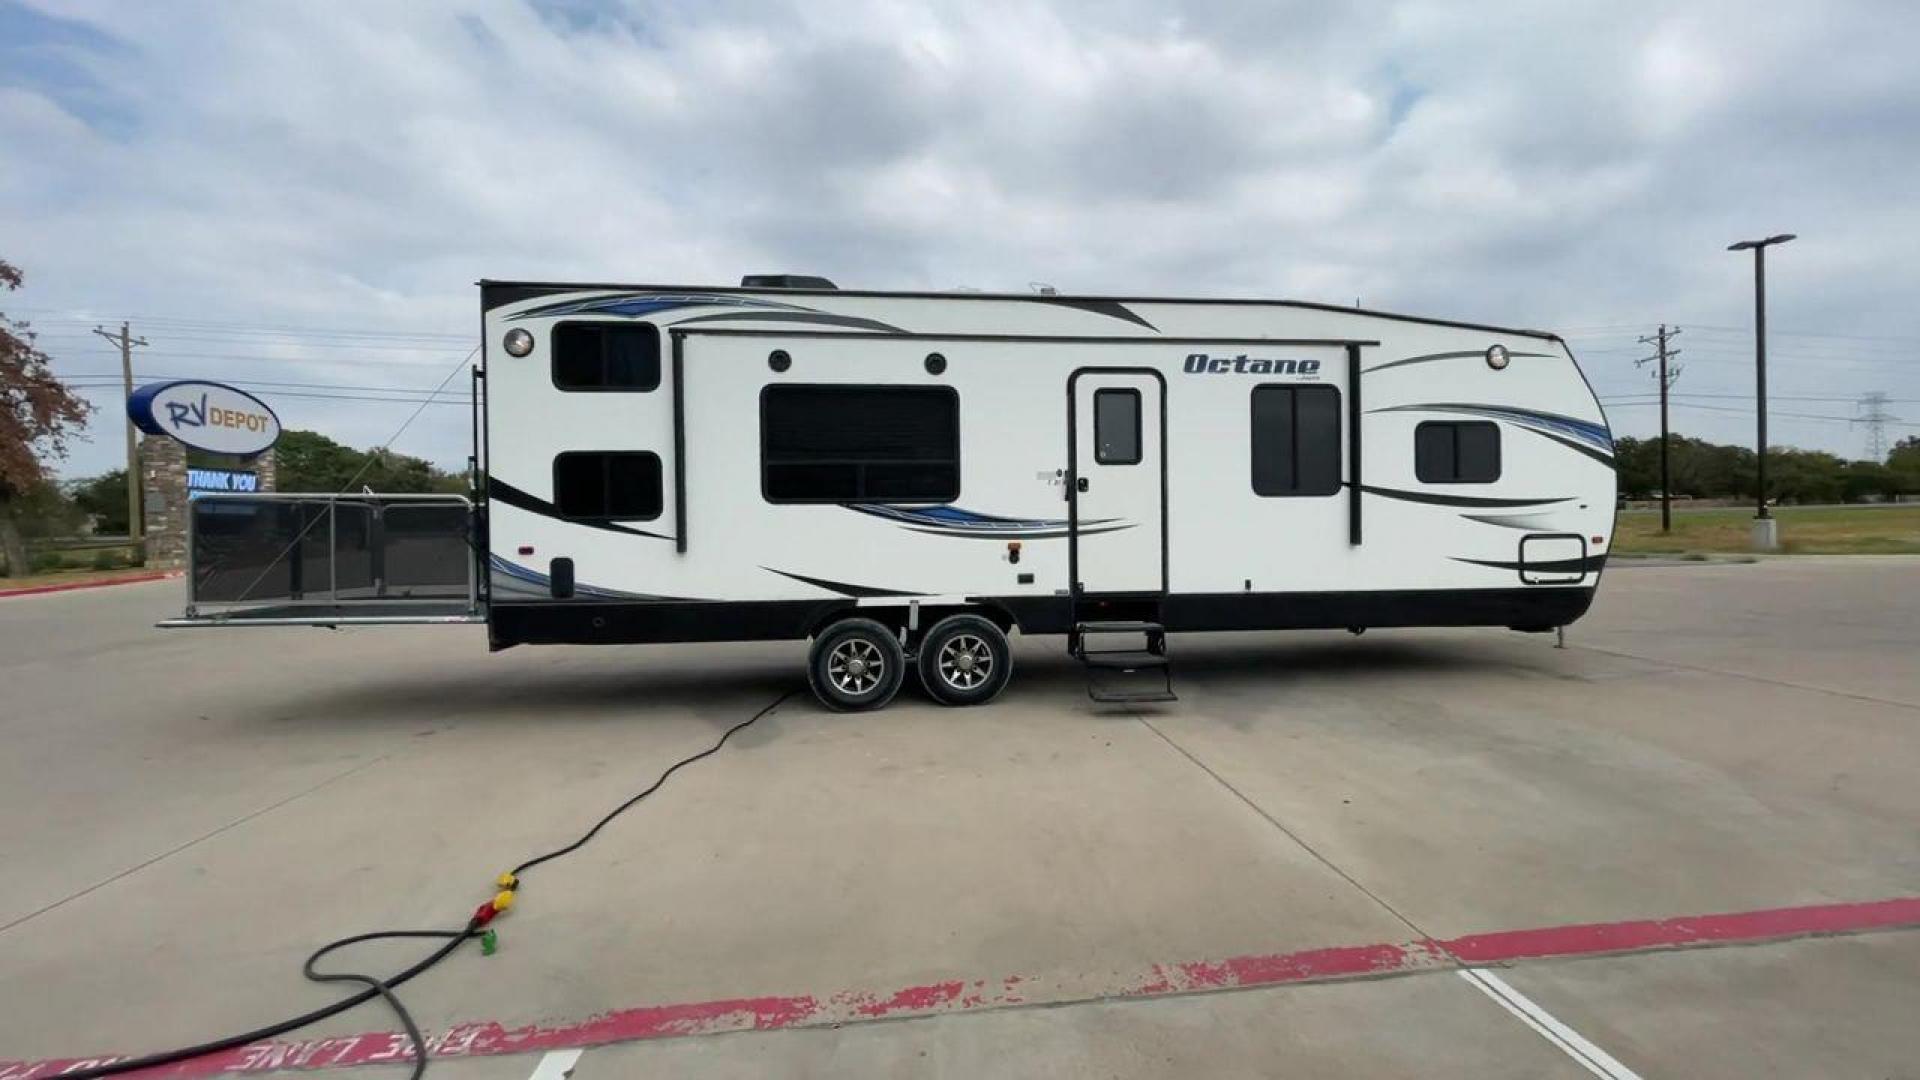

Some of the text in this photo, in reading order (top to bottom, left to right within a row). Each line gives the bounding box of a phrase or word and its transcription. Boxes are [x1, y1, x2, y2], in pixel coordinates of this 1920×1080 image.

[1184, 353, 1321, 375] Octane
[165, 393, 268, 433] RV DEPOT
[187, 470, 256, 491] THANK YOU
